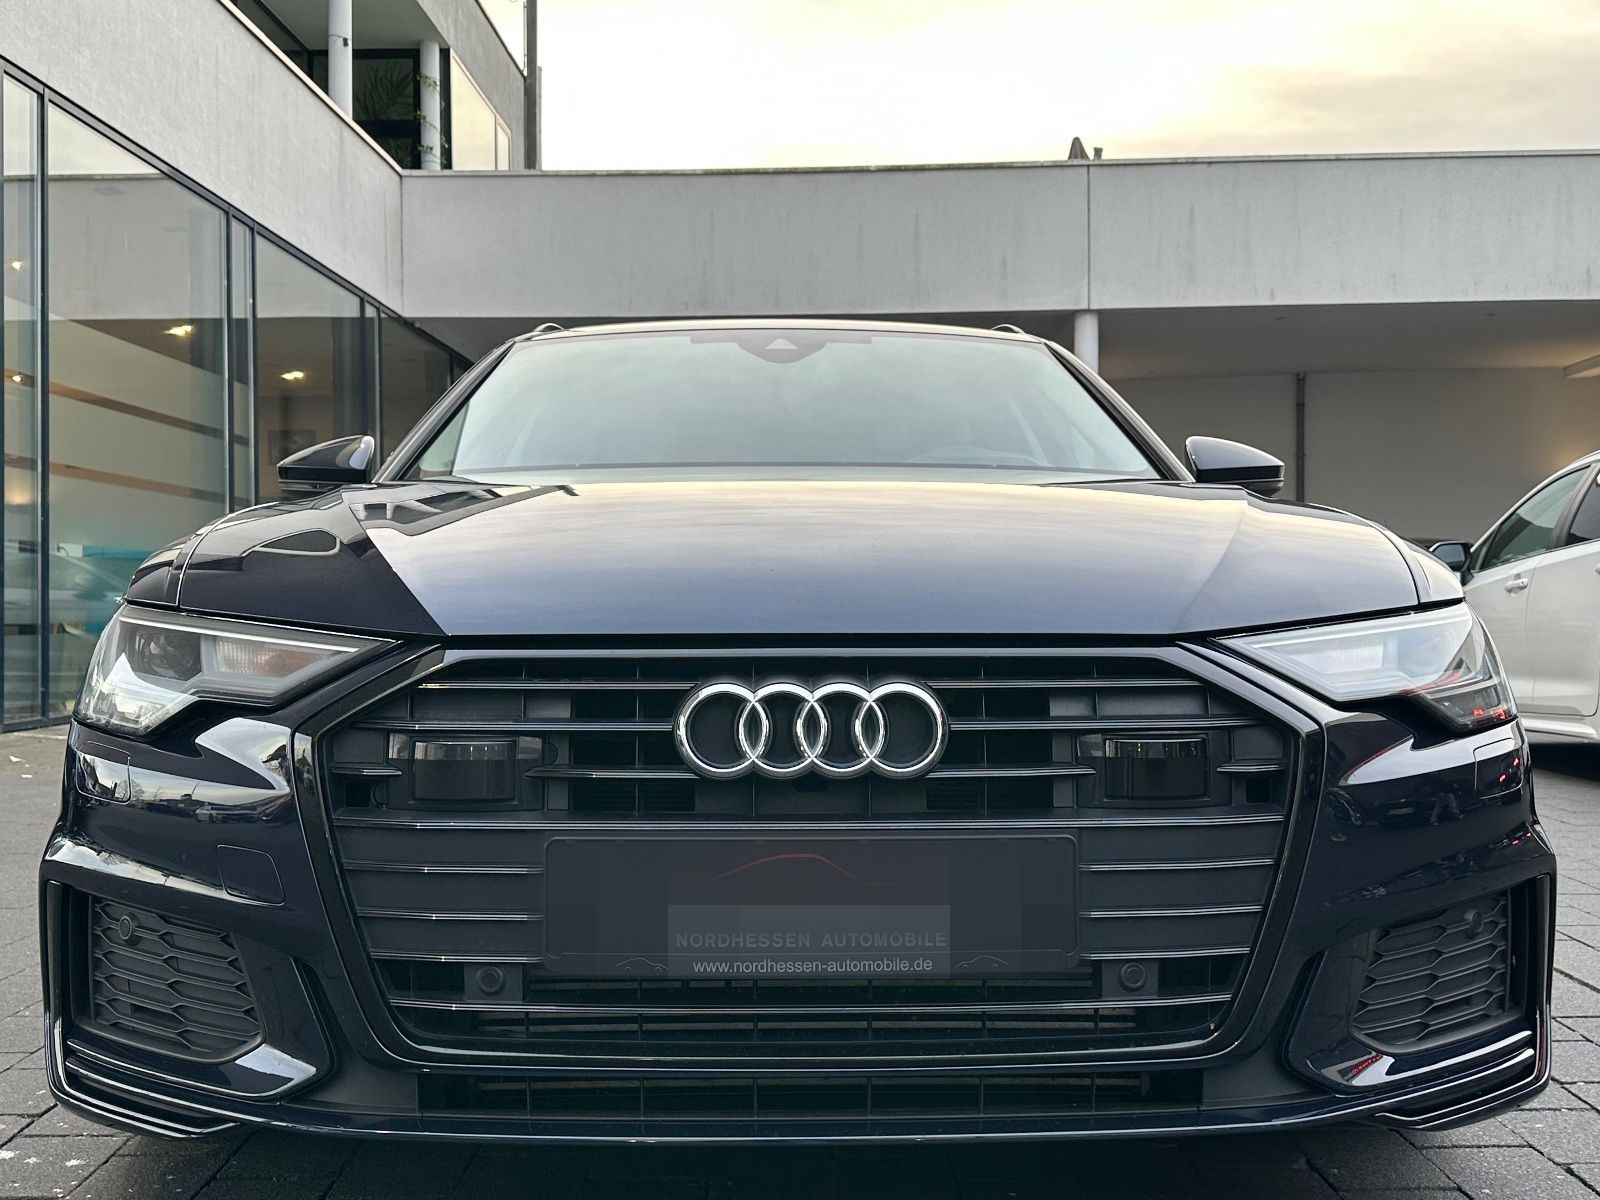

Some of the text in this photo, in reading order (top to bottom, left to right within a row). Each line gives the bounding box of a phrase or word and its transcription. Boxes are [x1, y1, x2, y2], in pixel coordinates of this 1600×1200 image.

[676, 932, 947, 948] NORDHESSEN AUTOMOBILE
[693, 957, 933, 973] www.nordhessen-automobile.de
